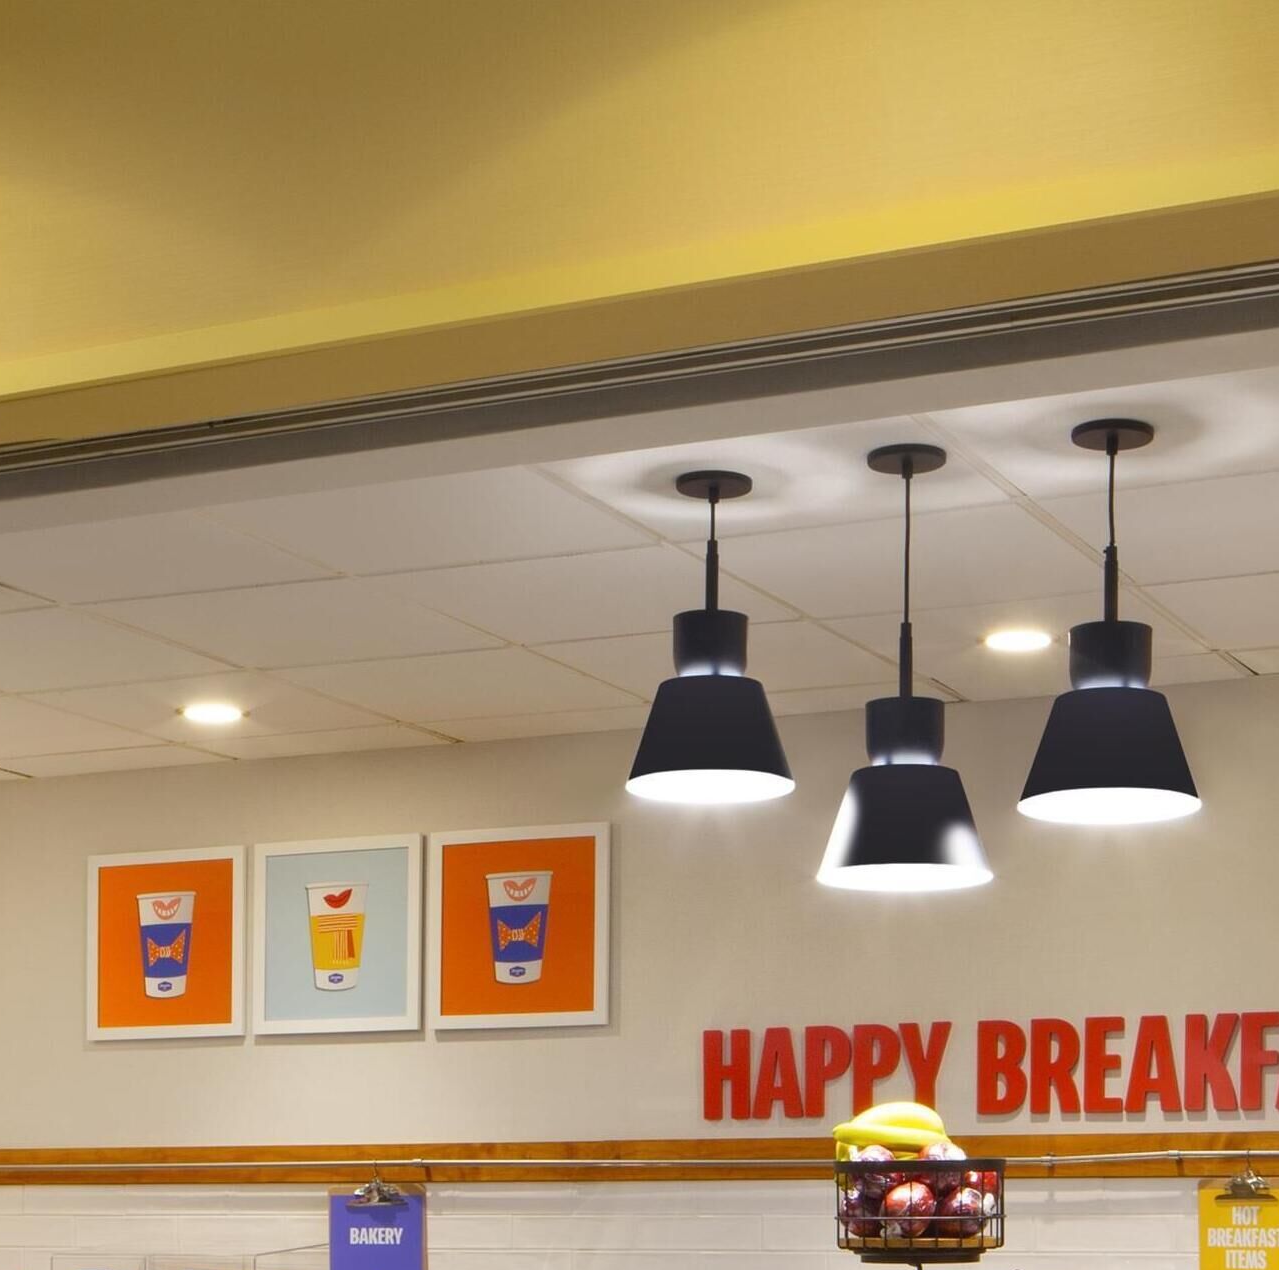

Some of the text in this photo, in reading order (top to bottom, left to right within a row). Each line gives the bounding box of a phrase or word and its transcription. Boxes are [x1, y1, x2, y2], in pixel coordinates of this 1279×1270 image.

[702, 1020, 952, 1121] HAPPY
[1232, 1205, 1259, 1226] HOT
[349, 1227, 404, 1245] BAKERY
[1225, 1249, 1268, 1270] ITEMS
